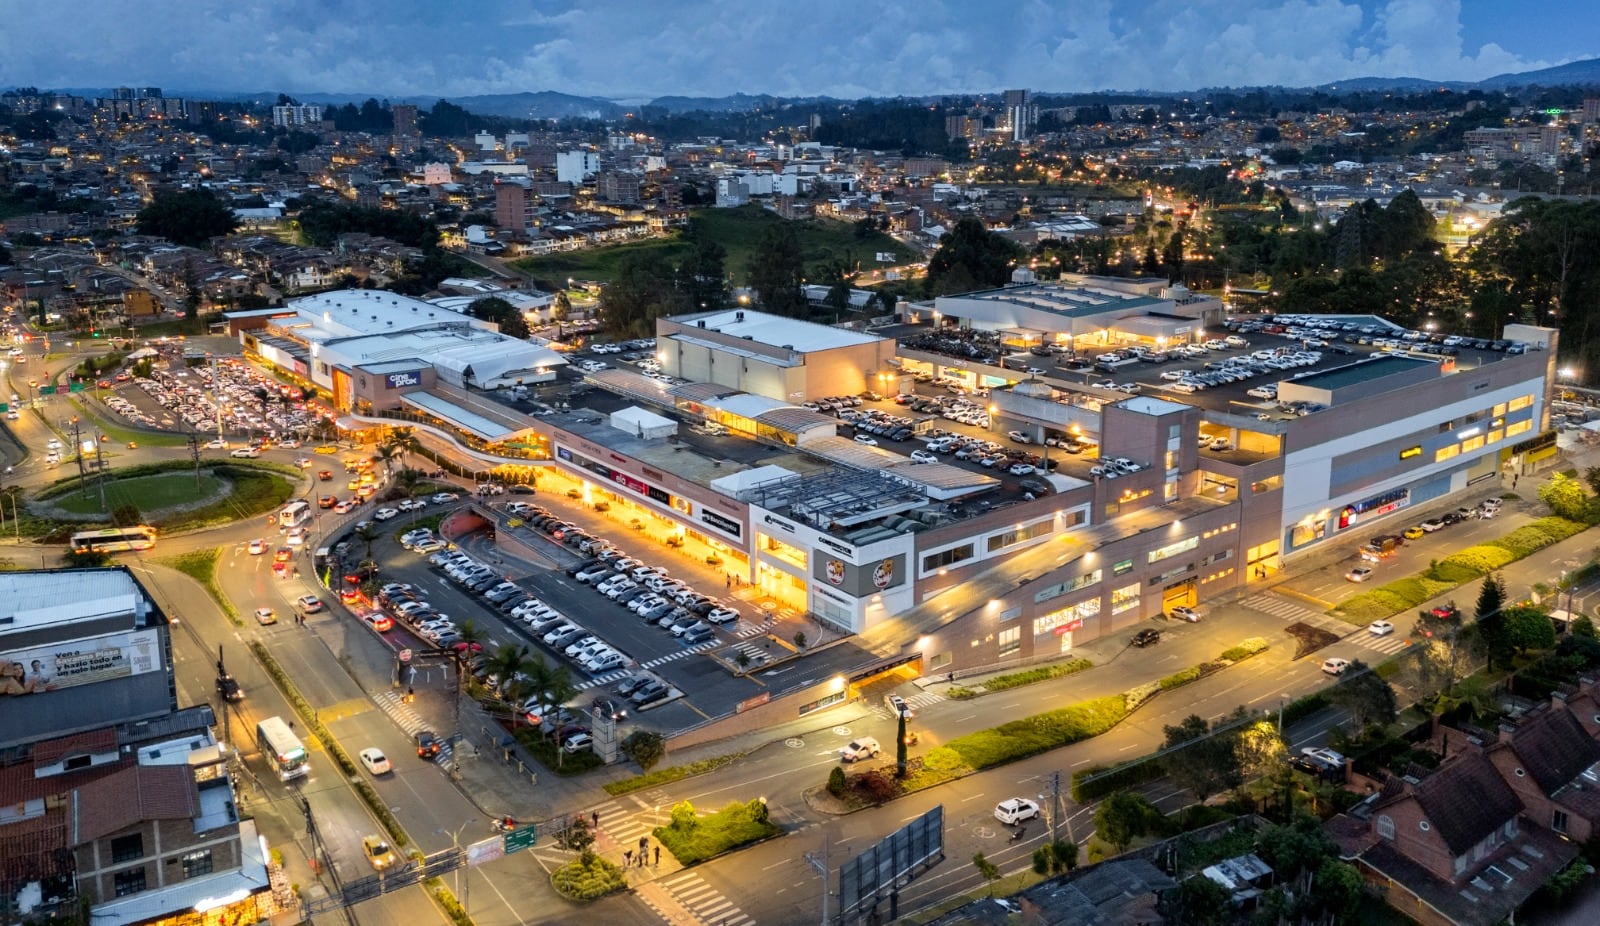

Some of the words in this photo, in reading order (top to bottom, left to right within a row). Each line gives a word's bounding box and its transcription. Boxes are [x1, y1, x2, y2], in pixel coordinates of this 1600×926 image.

[389, 374, 409, 382] cine
[395, 378, 417, 388] prox
[55, 651, 71, 659] Ven
[55, 653, 95, 665] Savanna
[95, 649, 119, 659] Plaza
[64, 660, 88, 669] hazlo
[89, 656, 110, 665] todo
